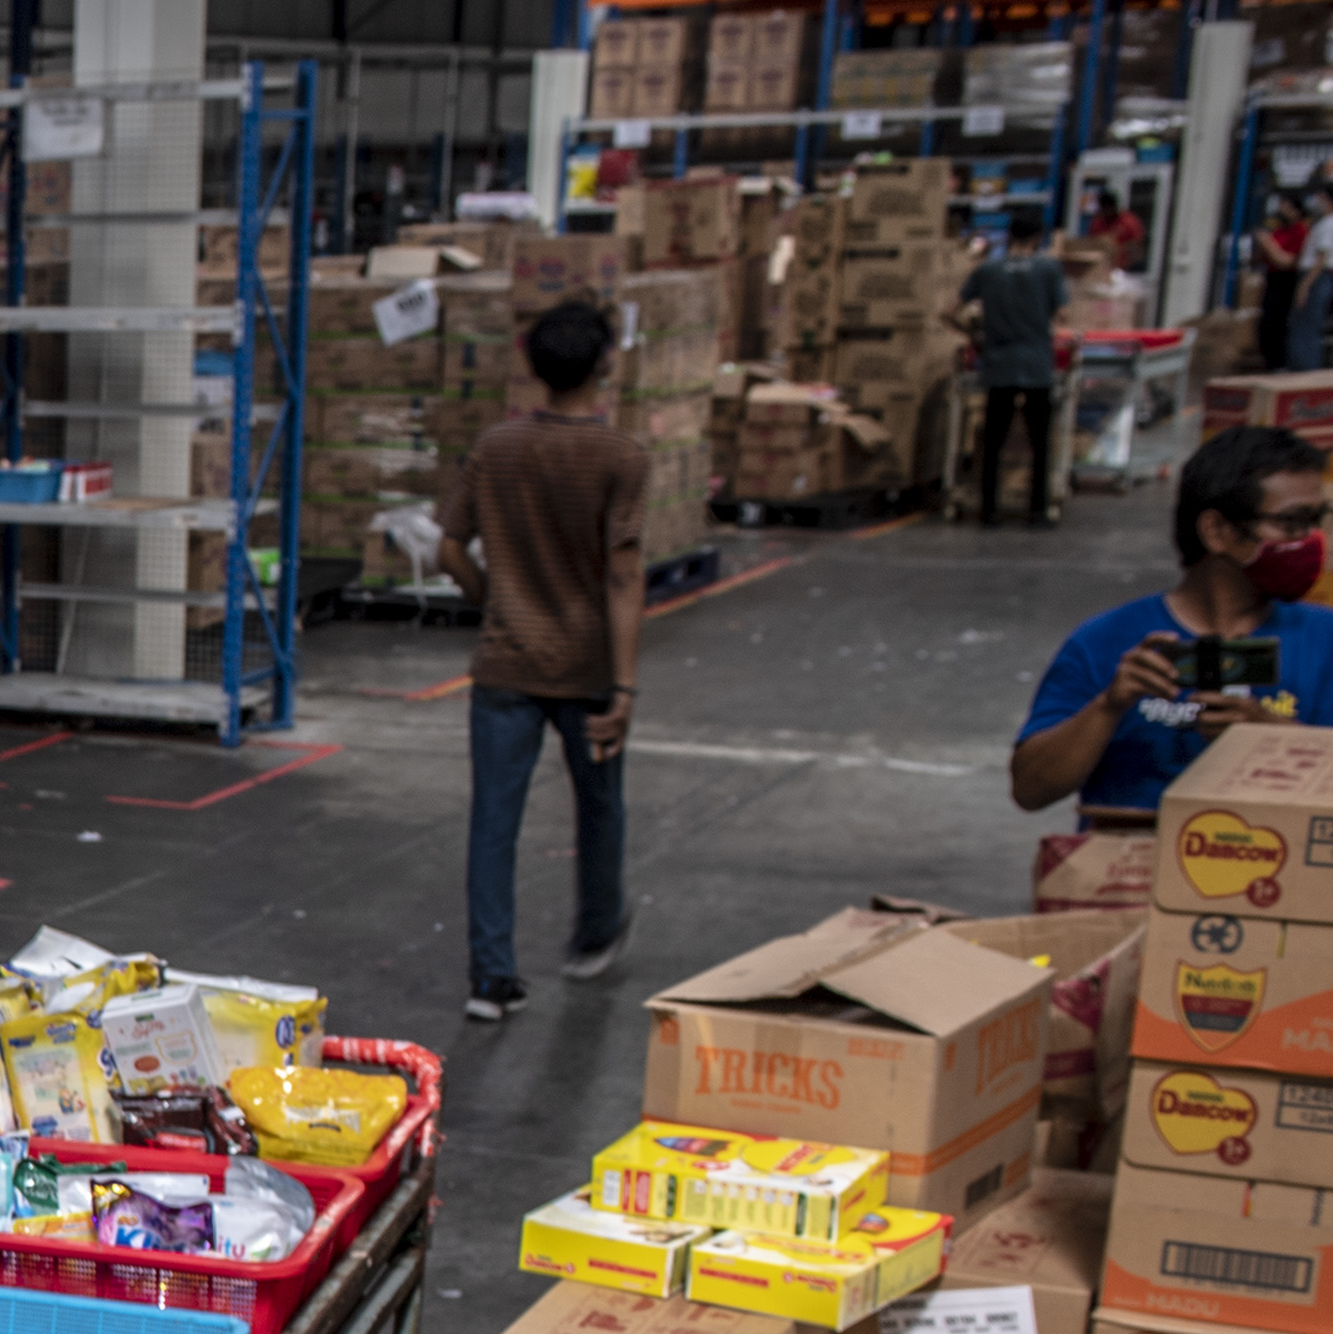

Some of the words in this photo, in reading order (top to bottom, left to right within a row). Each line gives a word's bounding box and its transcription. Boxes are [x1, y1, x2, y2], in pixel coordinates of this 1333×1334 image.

[1185, 833, 1280, 863] Dancow
[694, 1046, 844, 1111] TRICKS
[1158, 1090, 1251, 1122] Dancow
[1146, 1290, 1221, 1320] MADU
